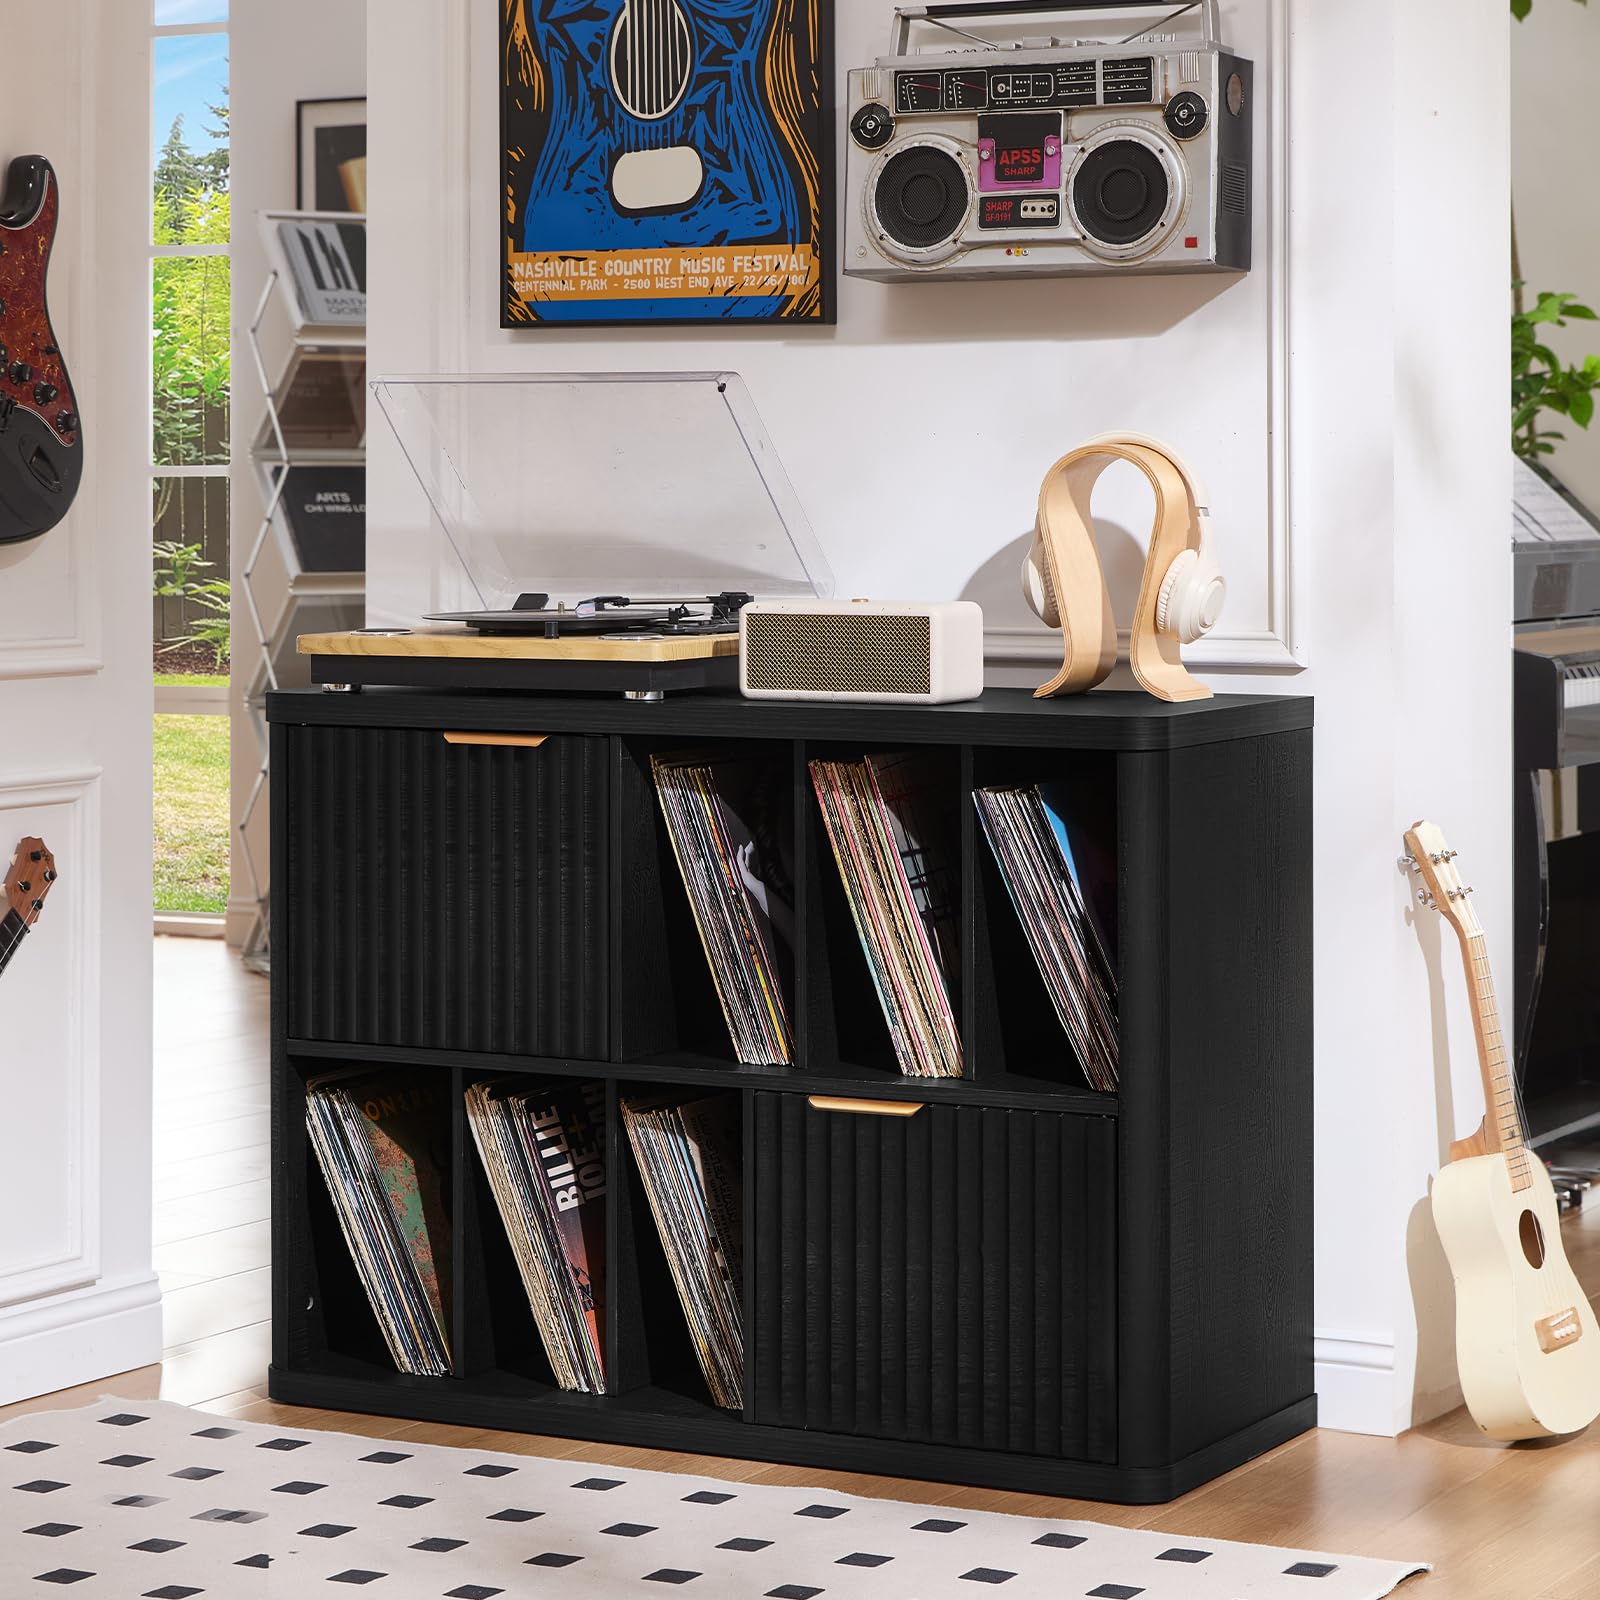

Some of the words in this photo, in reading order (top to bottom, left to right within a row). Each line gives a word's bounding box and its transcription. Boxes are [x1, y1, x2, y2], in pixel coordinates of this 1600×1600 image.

[999, 148, 1042, 166] APSS
[1003, 166, 1036, 176] SHARP
[985, 200, 1014, 211] SHARP
[513, 259, 597, 279] NASHVILLE
[604, 257, 672, 277] COUNTRY
[679, 256, 726, 274] MUSIC
[733, 252, 809, 273] FESTIVAL
[512, 279, 576, 293] CENTENNIAL
[580, 278, 608, 291] PARK
[623, 278, 651, 290] 2500
[655, 276, 684, 289] WEST
[688, 275, 710, 288] END
[713, 274, 735, 287] AVE
[316, 492, 350, 503] ARTS
[529, 1104, 586, 1213] BILLIE
